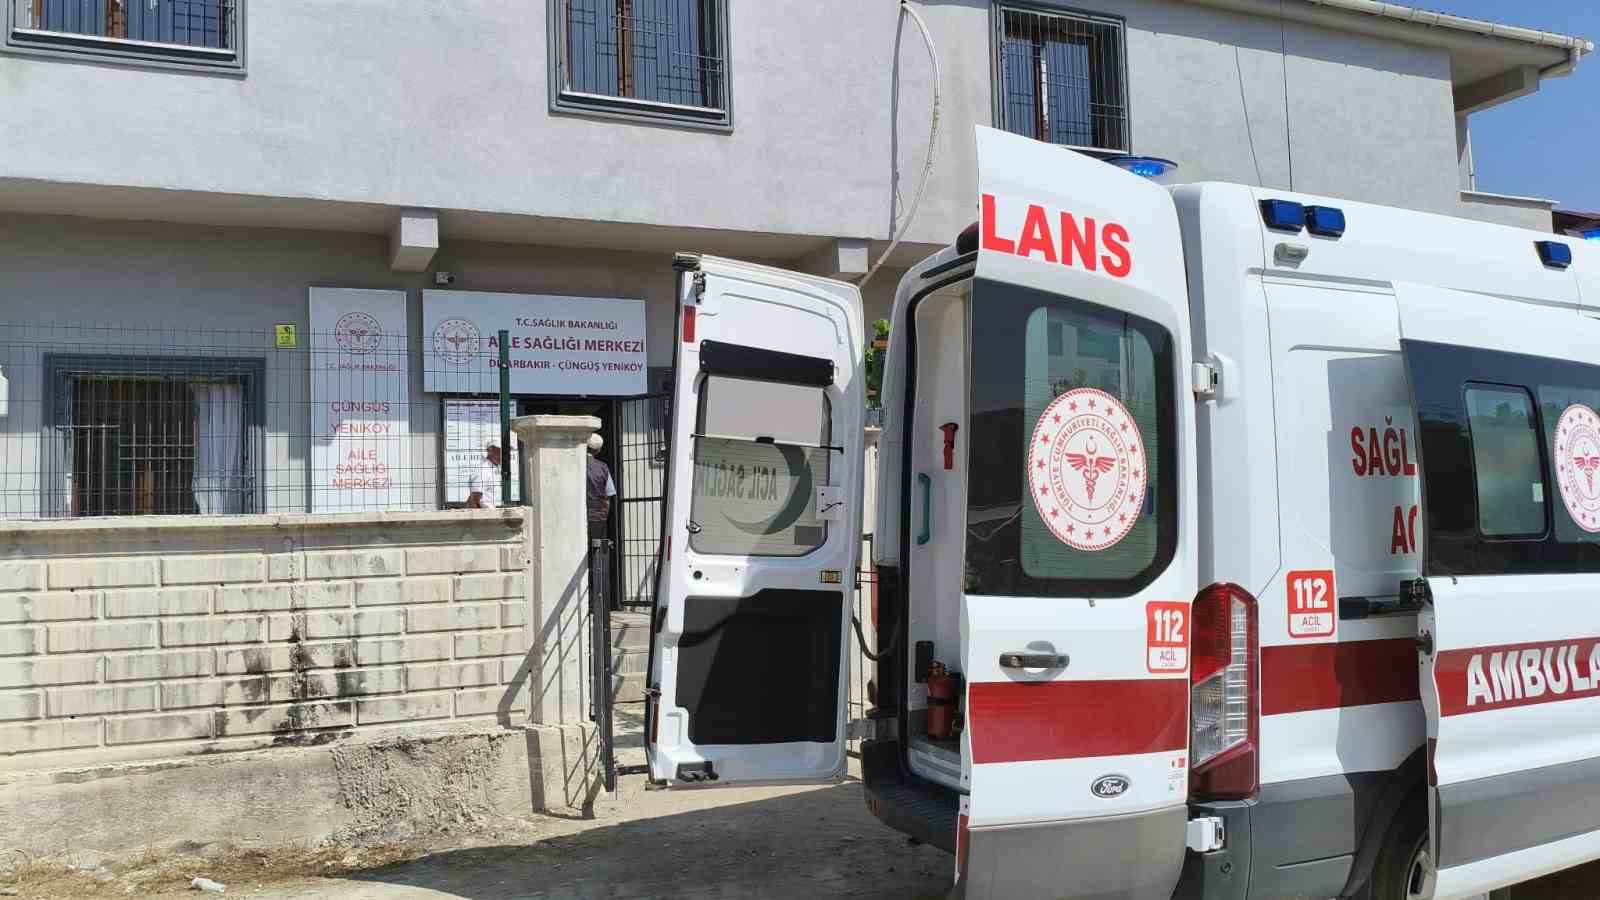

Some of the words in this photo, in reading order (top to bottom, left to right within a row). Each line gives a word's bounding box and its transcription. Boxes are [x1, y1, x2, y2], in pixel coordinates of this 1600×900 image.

[982, 194, 1132, 278] LANS
[524, 336, 582, 351] SAĞLIĞI
[585, 339, 644, 353] MERKEZİ
[558, 360, 600, 372] ÇÜNGÜŞ
[1293, 578, 1328, 609] 112
[1154, 608, 1184, 643] 112
[1100, 779, 1125, 794] Ford
